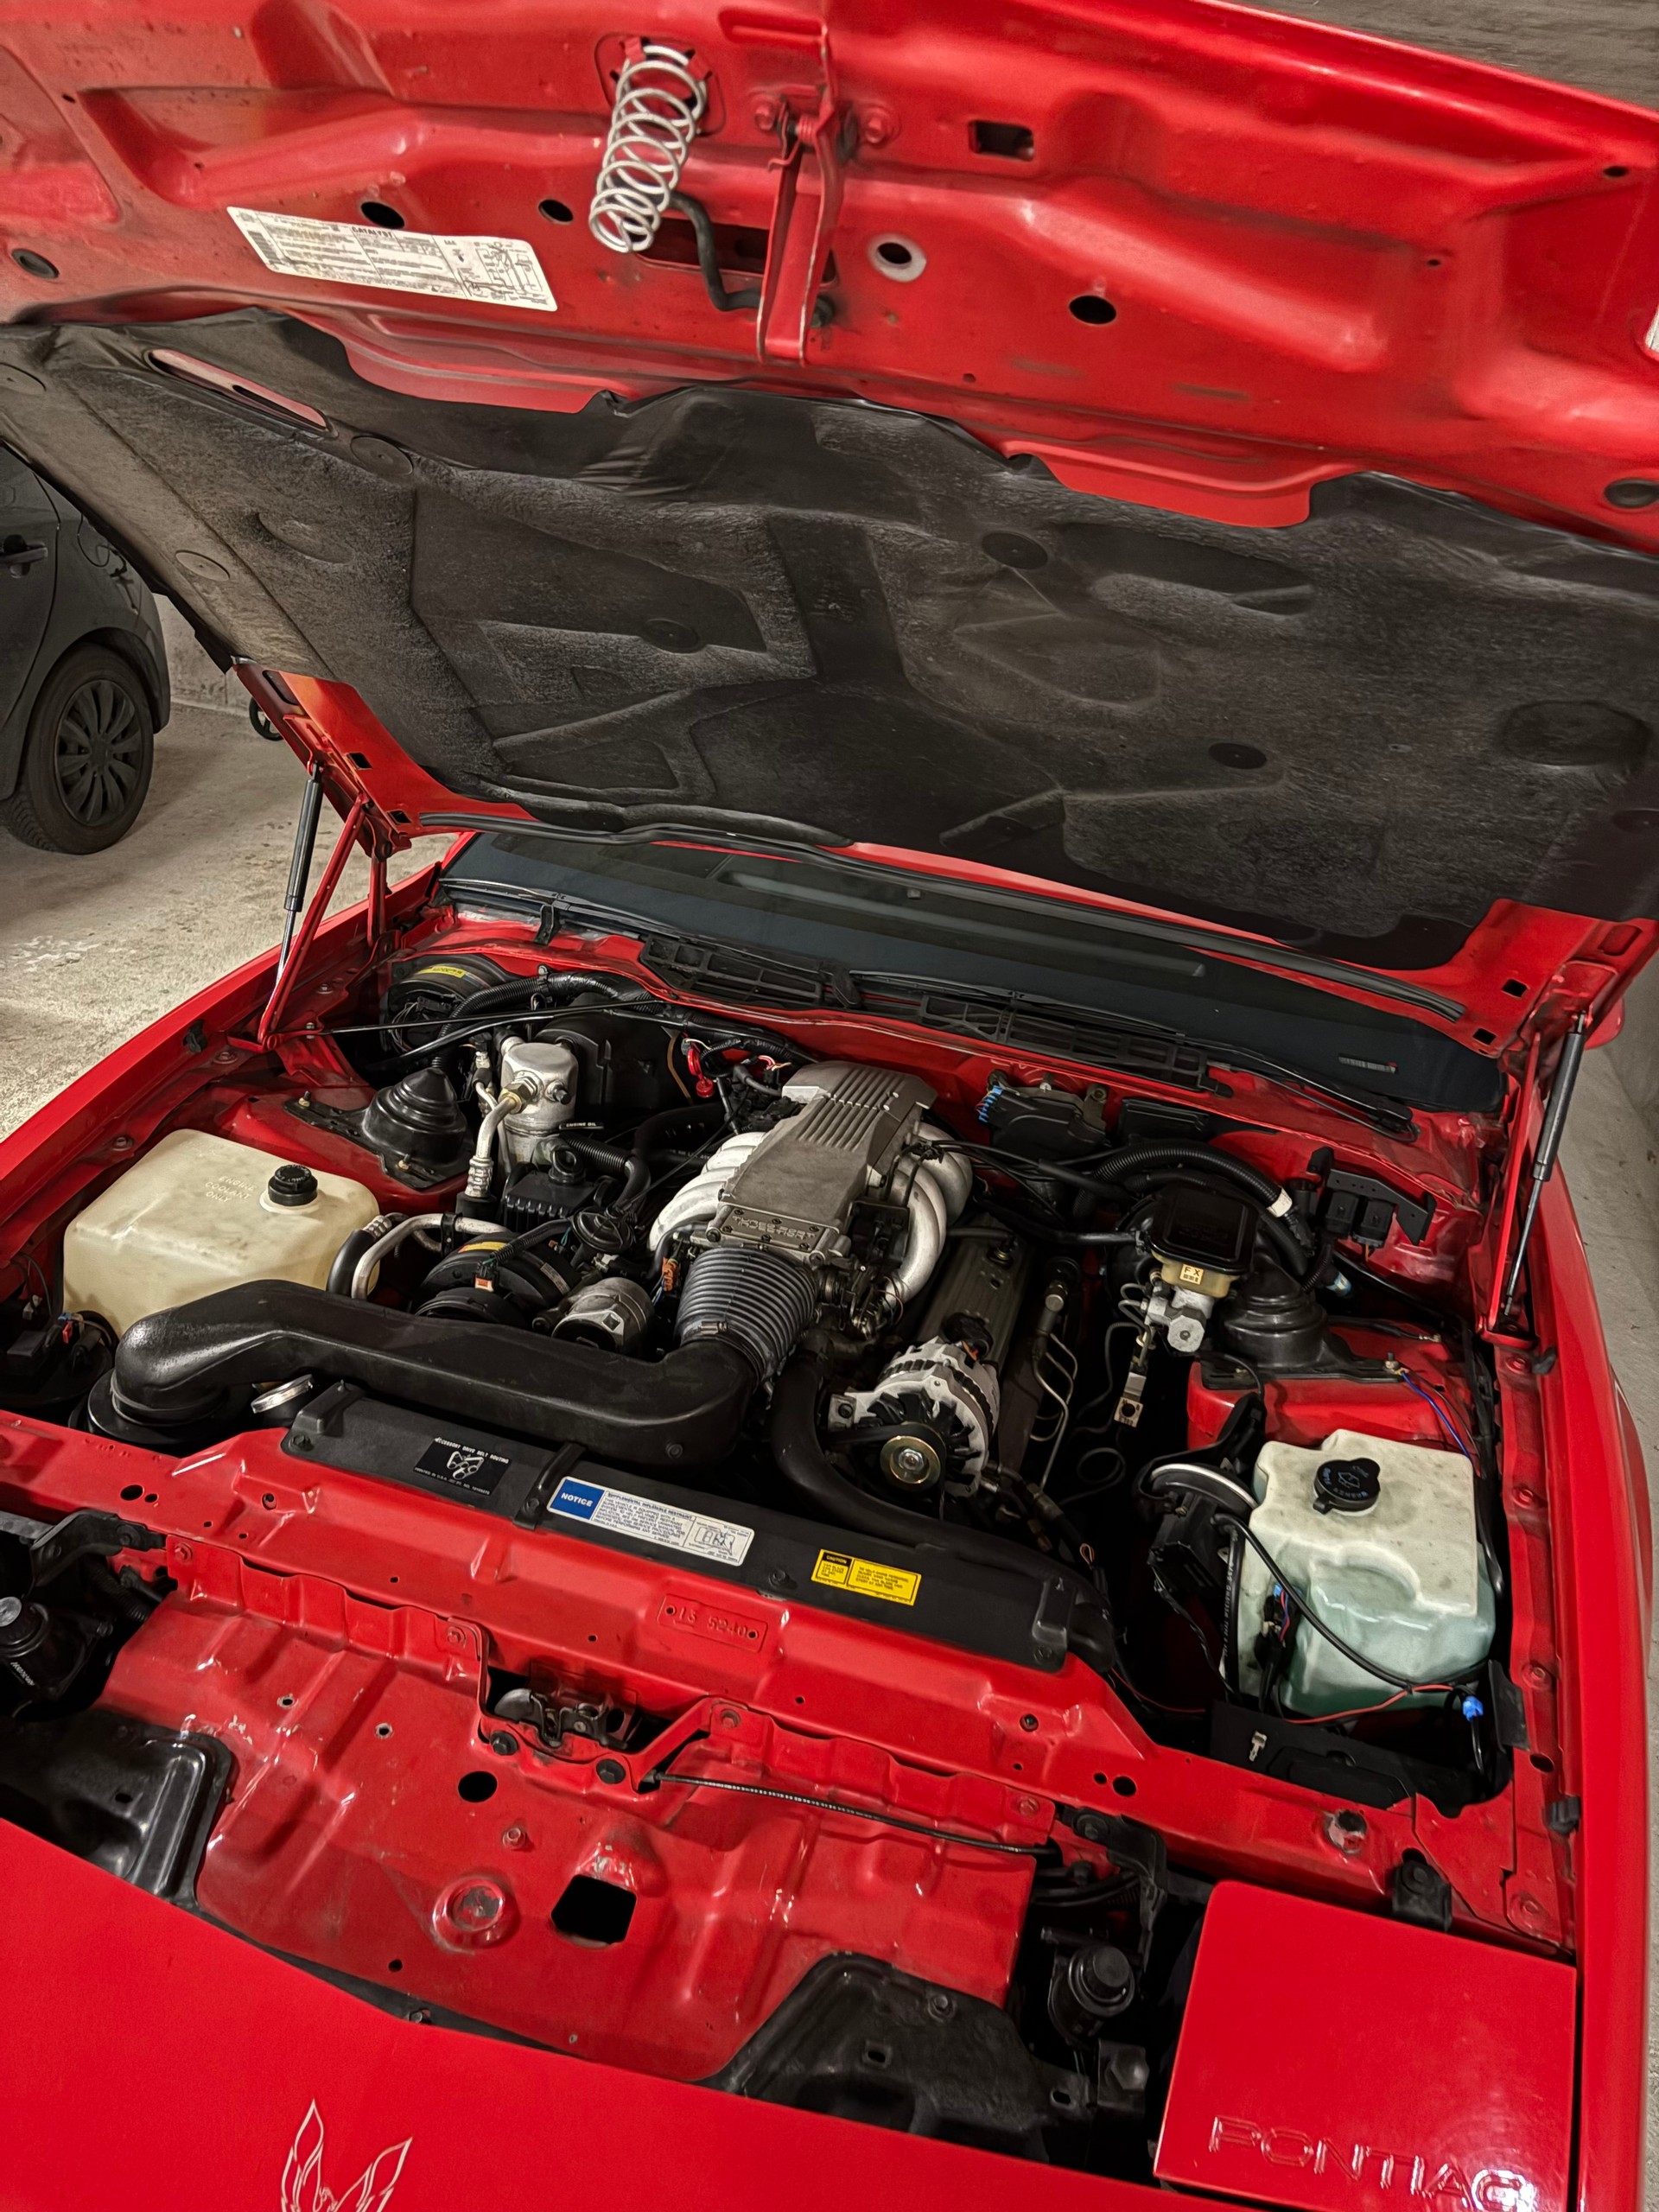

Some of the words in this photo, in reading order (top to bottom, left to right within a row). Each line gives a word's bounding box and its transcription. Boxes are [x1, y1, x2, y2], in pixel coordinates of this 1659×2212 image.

[352, 226, 393, 238] CATALYST
[205, 1181, 251, 1200] COOLANT
[219, 1175, 255, 1192] ENGINE
[206, 1191, 232, 1203] ONLY
[434, 1437, 461, 1448] ACCESSORY
[489, 1454, 509, 1464] ROUTING
[561, 1492, 594, 1507] NOTICE
[826, 1555, 847, 1564] CAUTION
[1209, 2115, 1538, 2212] PONTIAC
